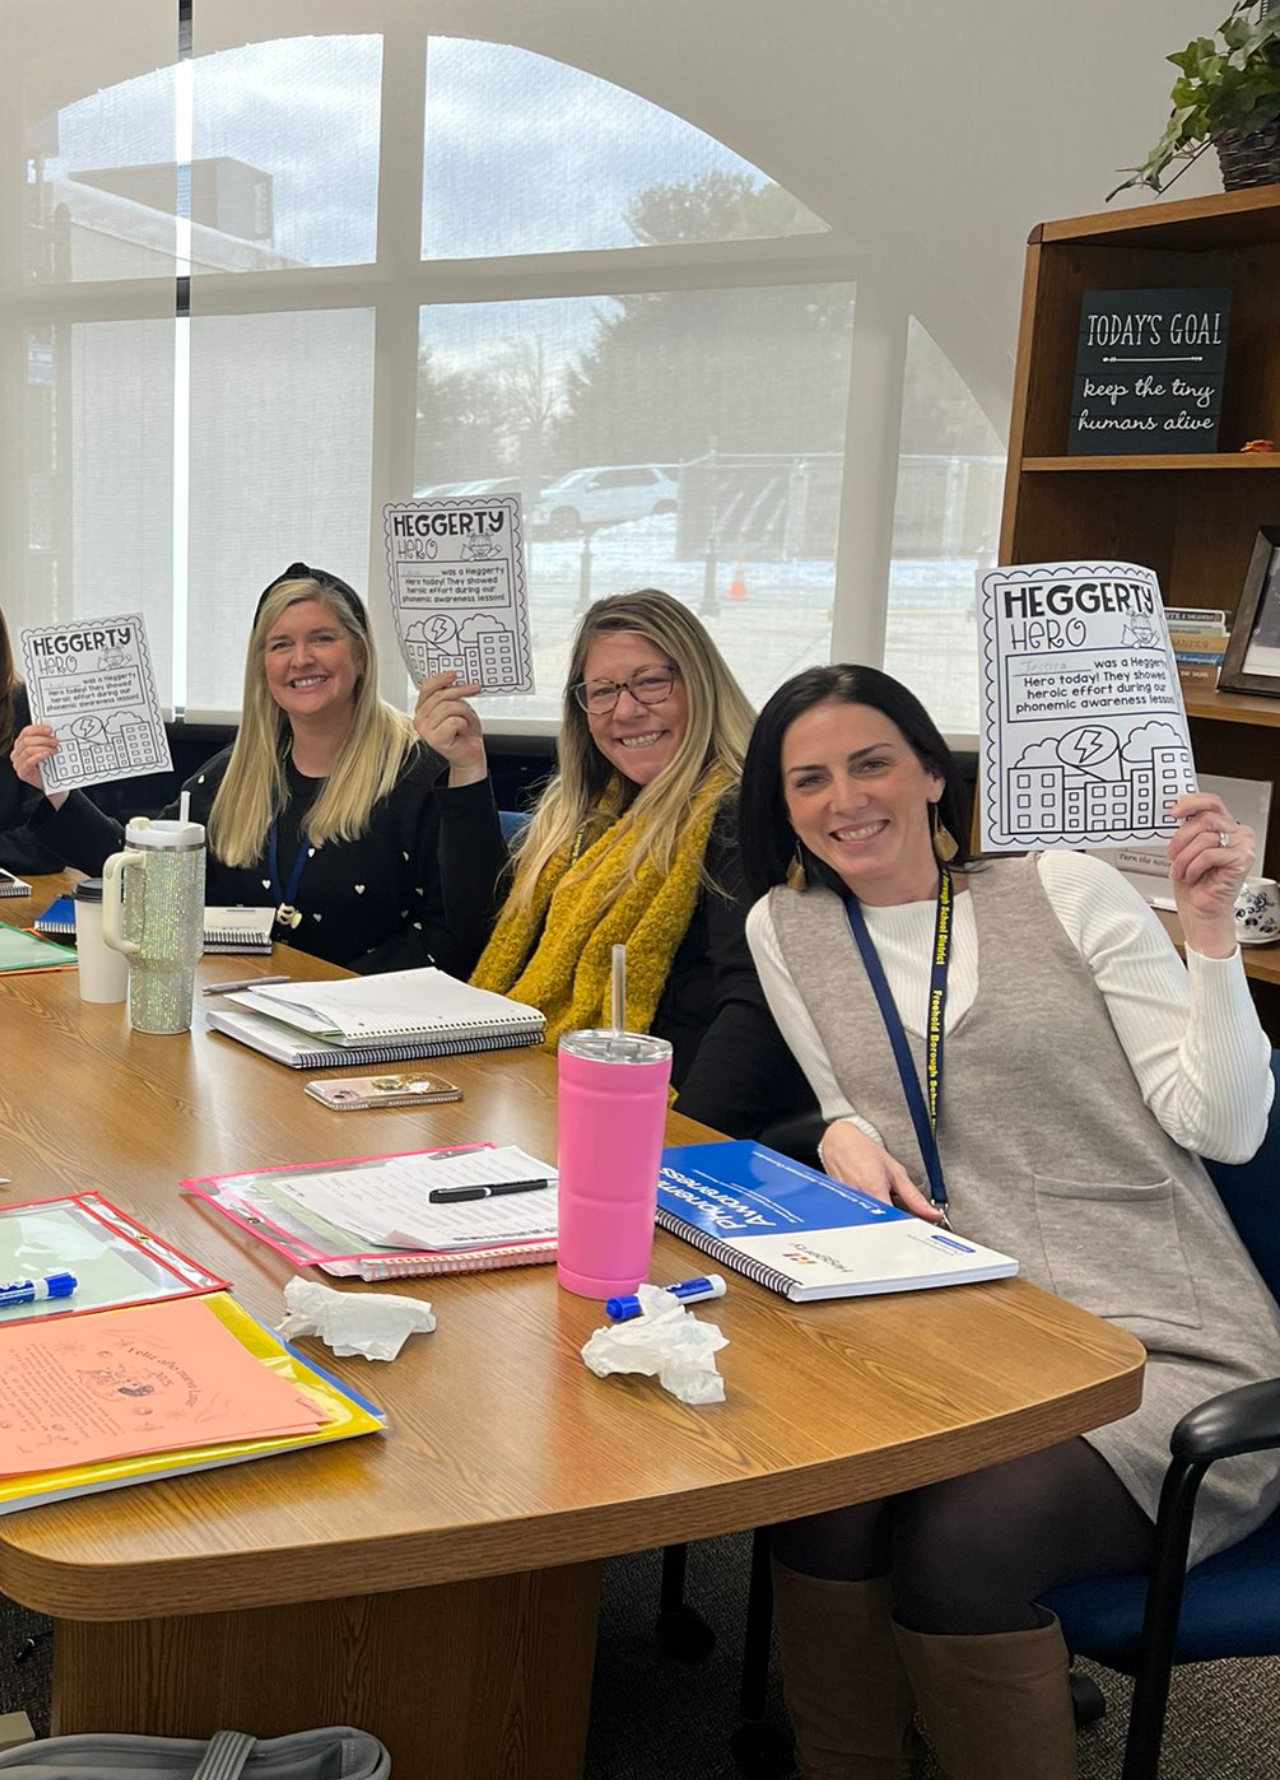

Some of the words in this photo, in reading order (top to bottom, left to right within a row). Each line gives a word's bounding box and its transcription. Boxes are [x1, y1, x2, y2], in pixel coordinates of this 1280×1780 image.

[1088, 315, 1162, 345] TODAY'S
[1171, 313, 1222, 344] GOAL
[1084, 378, 1128, 405] keep
[1135, 375, 1166, 397] the
[1172, 378, 1215, 408] tiny
[1078, 409, 1158, 431] humans
[1164, 410, 1214, 430] alive
[394, 512, 504, 536] HEGGERTY
[1004, 583, 1154, 618] HEGGERTY
[33, 628, 130, 656] HEGGERTY
[1094, 659, 1117, 668] was
[1121, 659, 1128, 667] a
[1131, 657, 1166, 669] Hegger
[1025, 678, 1055, 687] Hero
[1060, 673, 1098, 684] today!
[1104, 671, 1130, 681] They
[1134, 671, 1165, 680] showed
[1028, 689, 1067, 699] heroic
[1072, 685, 1112, 696] effort
[1117, 683, 1151, 694] during
[1016, 700, 1076, 714] phonemic
[1081, 696, 1146, 708] awareness
[931, 989, 942, 1032] Freehold
[928, 1034, 940, 1077] Borough
[658, 1180, 748, 1230] Phonem
